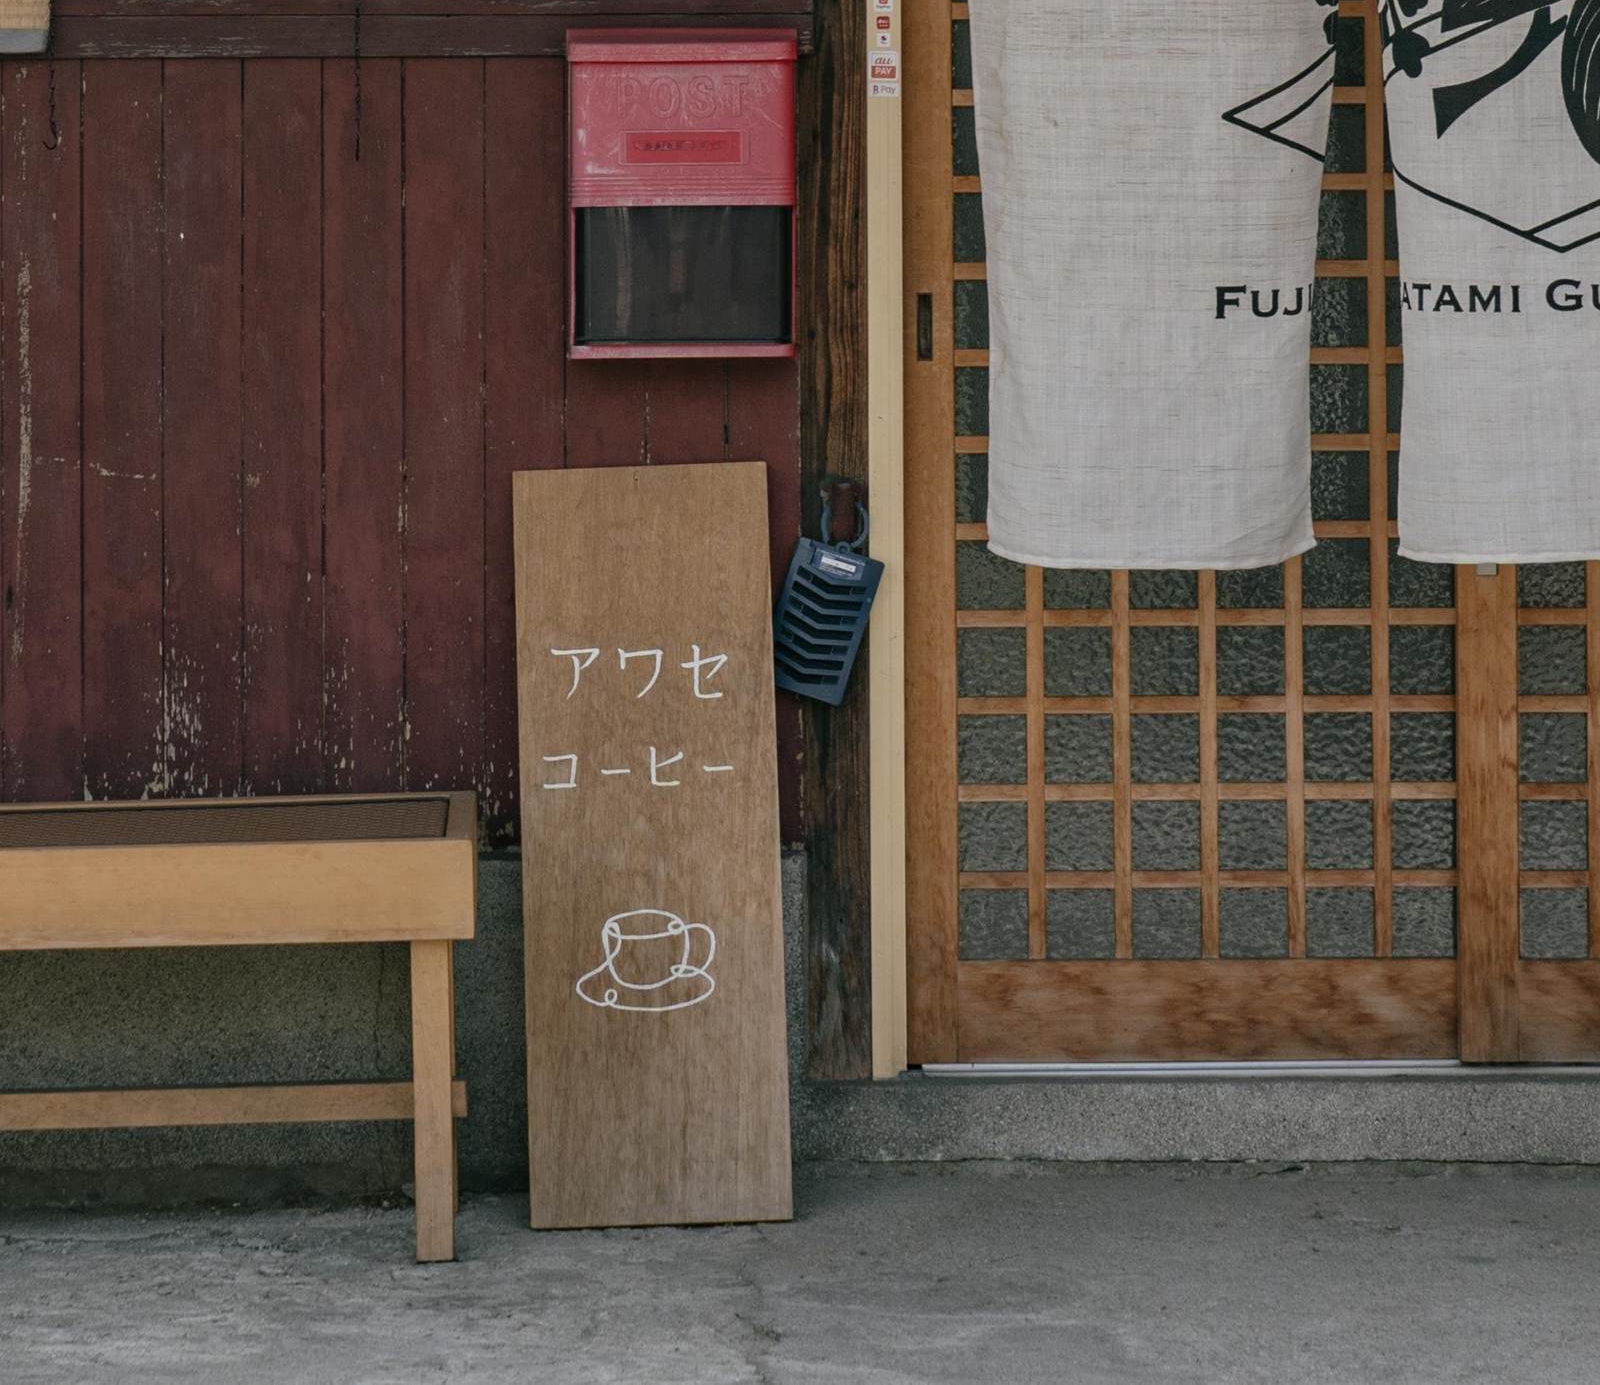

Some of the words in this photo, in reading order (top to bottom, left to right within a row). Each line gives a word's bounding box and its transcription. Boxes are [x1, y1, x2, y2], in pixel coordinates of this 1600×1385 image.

[874, 67, 893, 75] PAY
[615, 74, 750, 118] POST
[550, 644, 728, 699] アワセ
[543, 746, 734, 790] コーヒー
